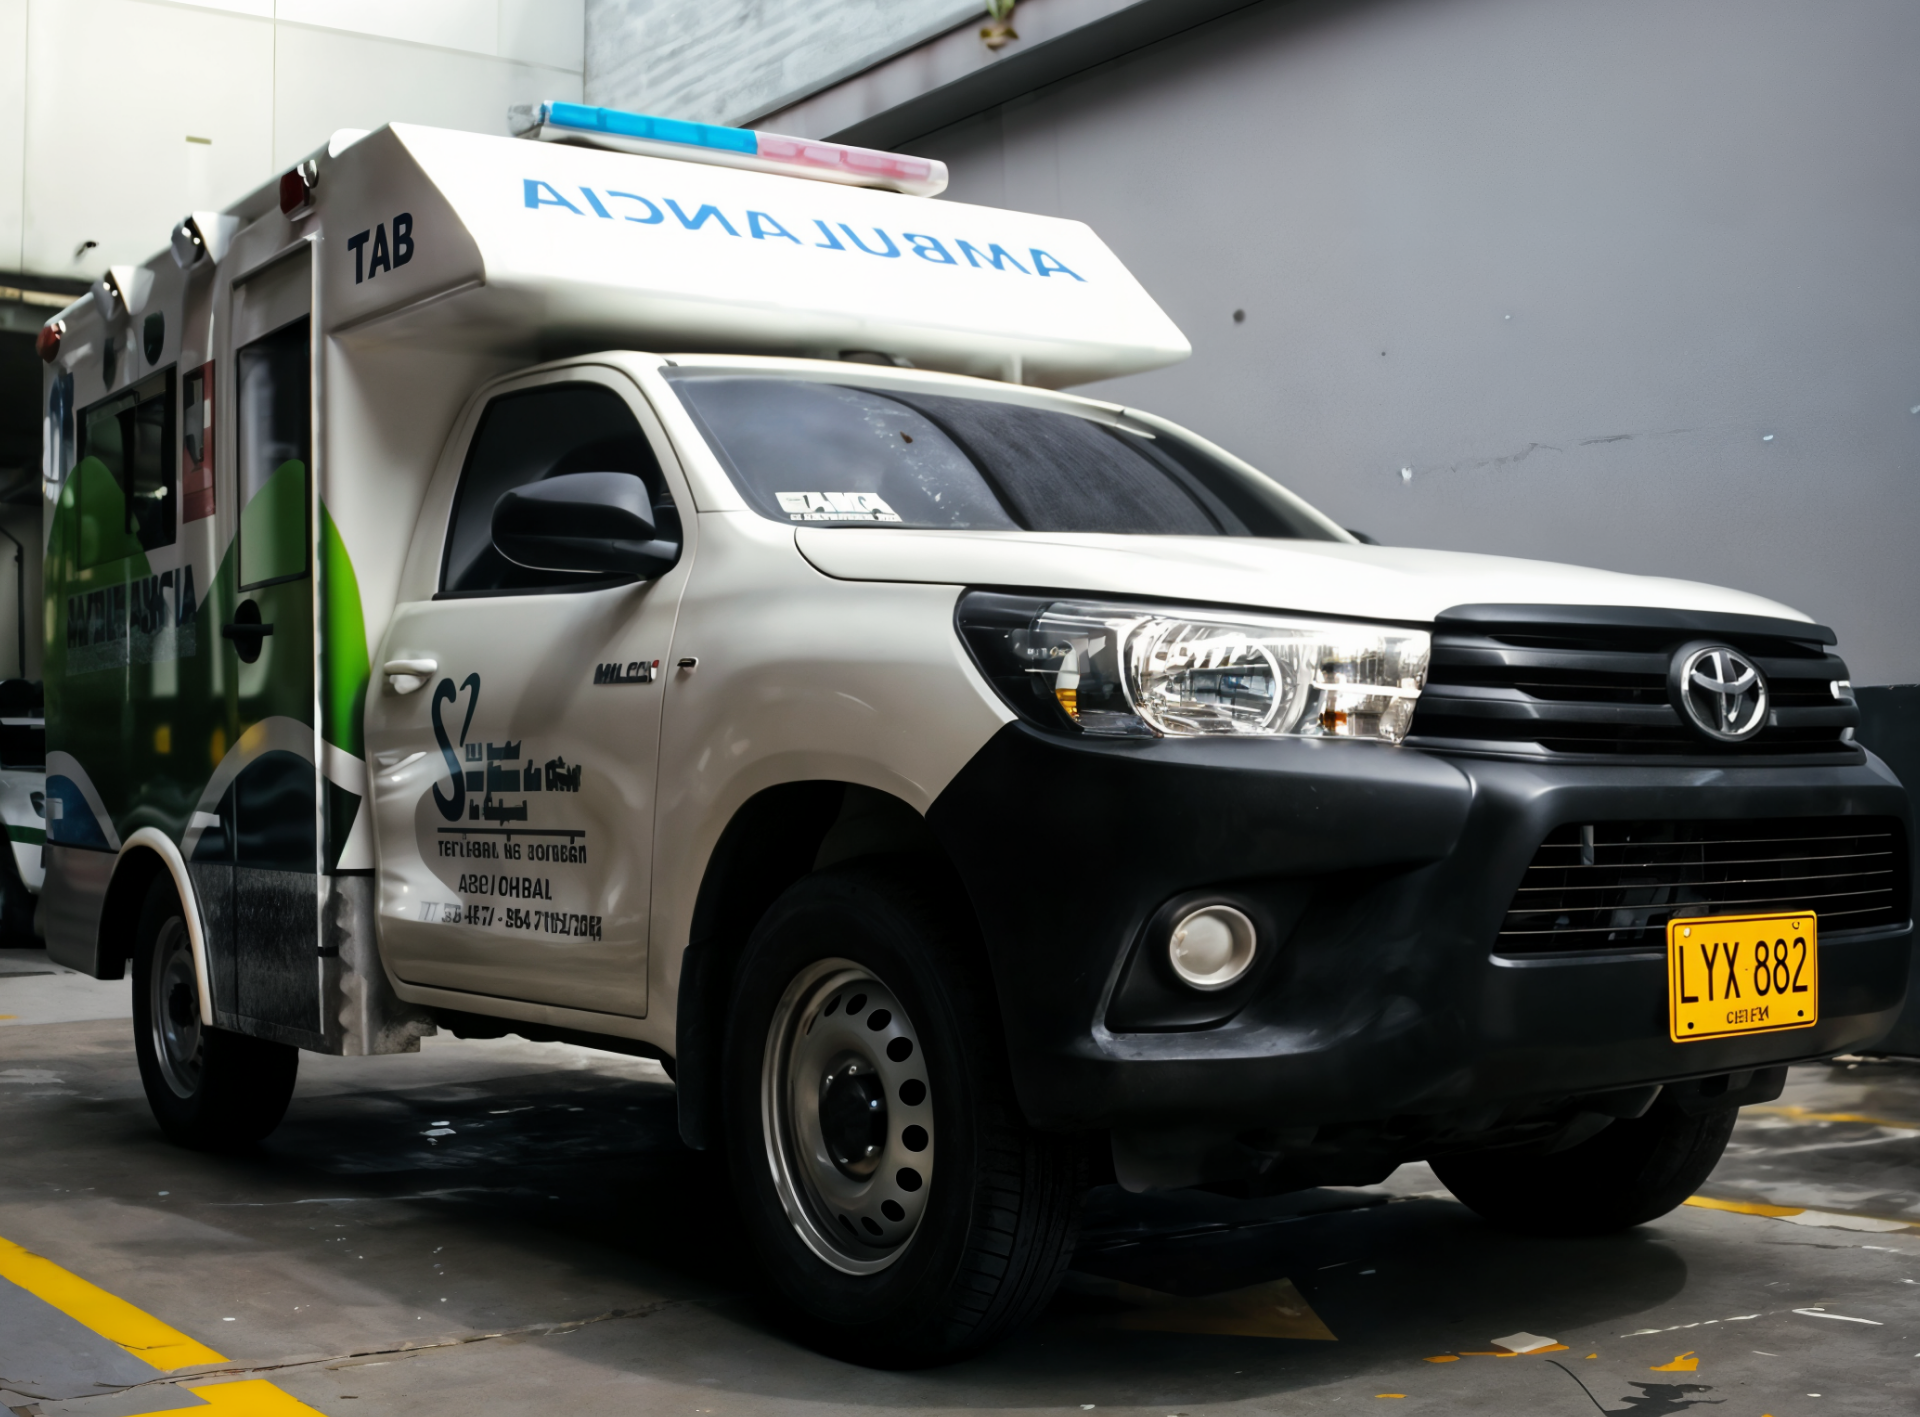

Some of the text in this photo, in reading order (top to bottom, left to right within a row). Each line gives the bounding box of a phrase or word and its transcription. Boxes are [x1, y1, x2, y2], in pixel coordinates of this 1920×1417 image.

[347, 212, 415, 285] TAB
[1678, 936, 1808, 1004] LYX 882
